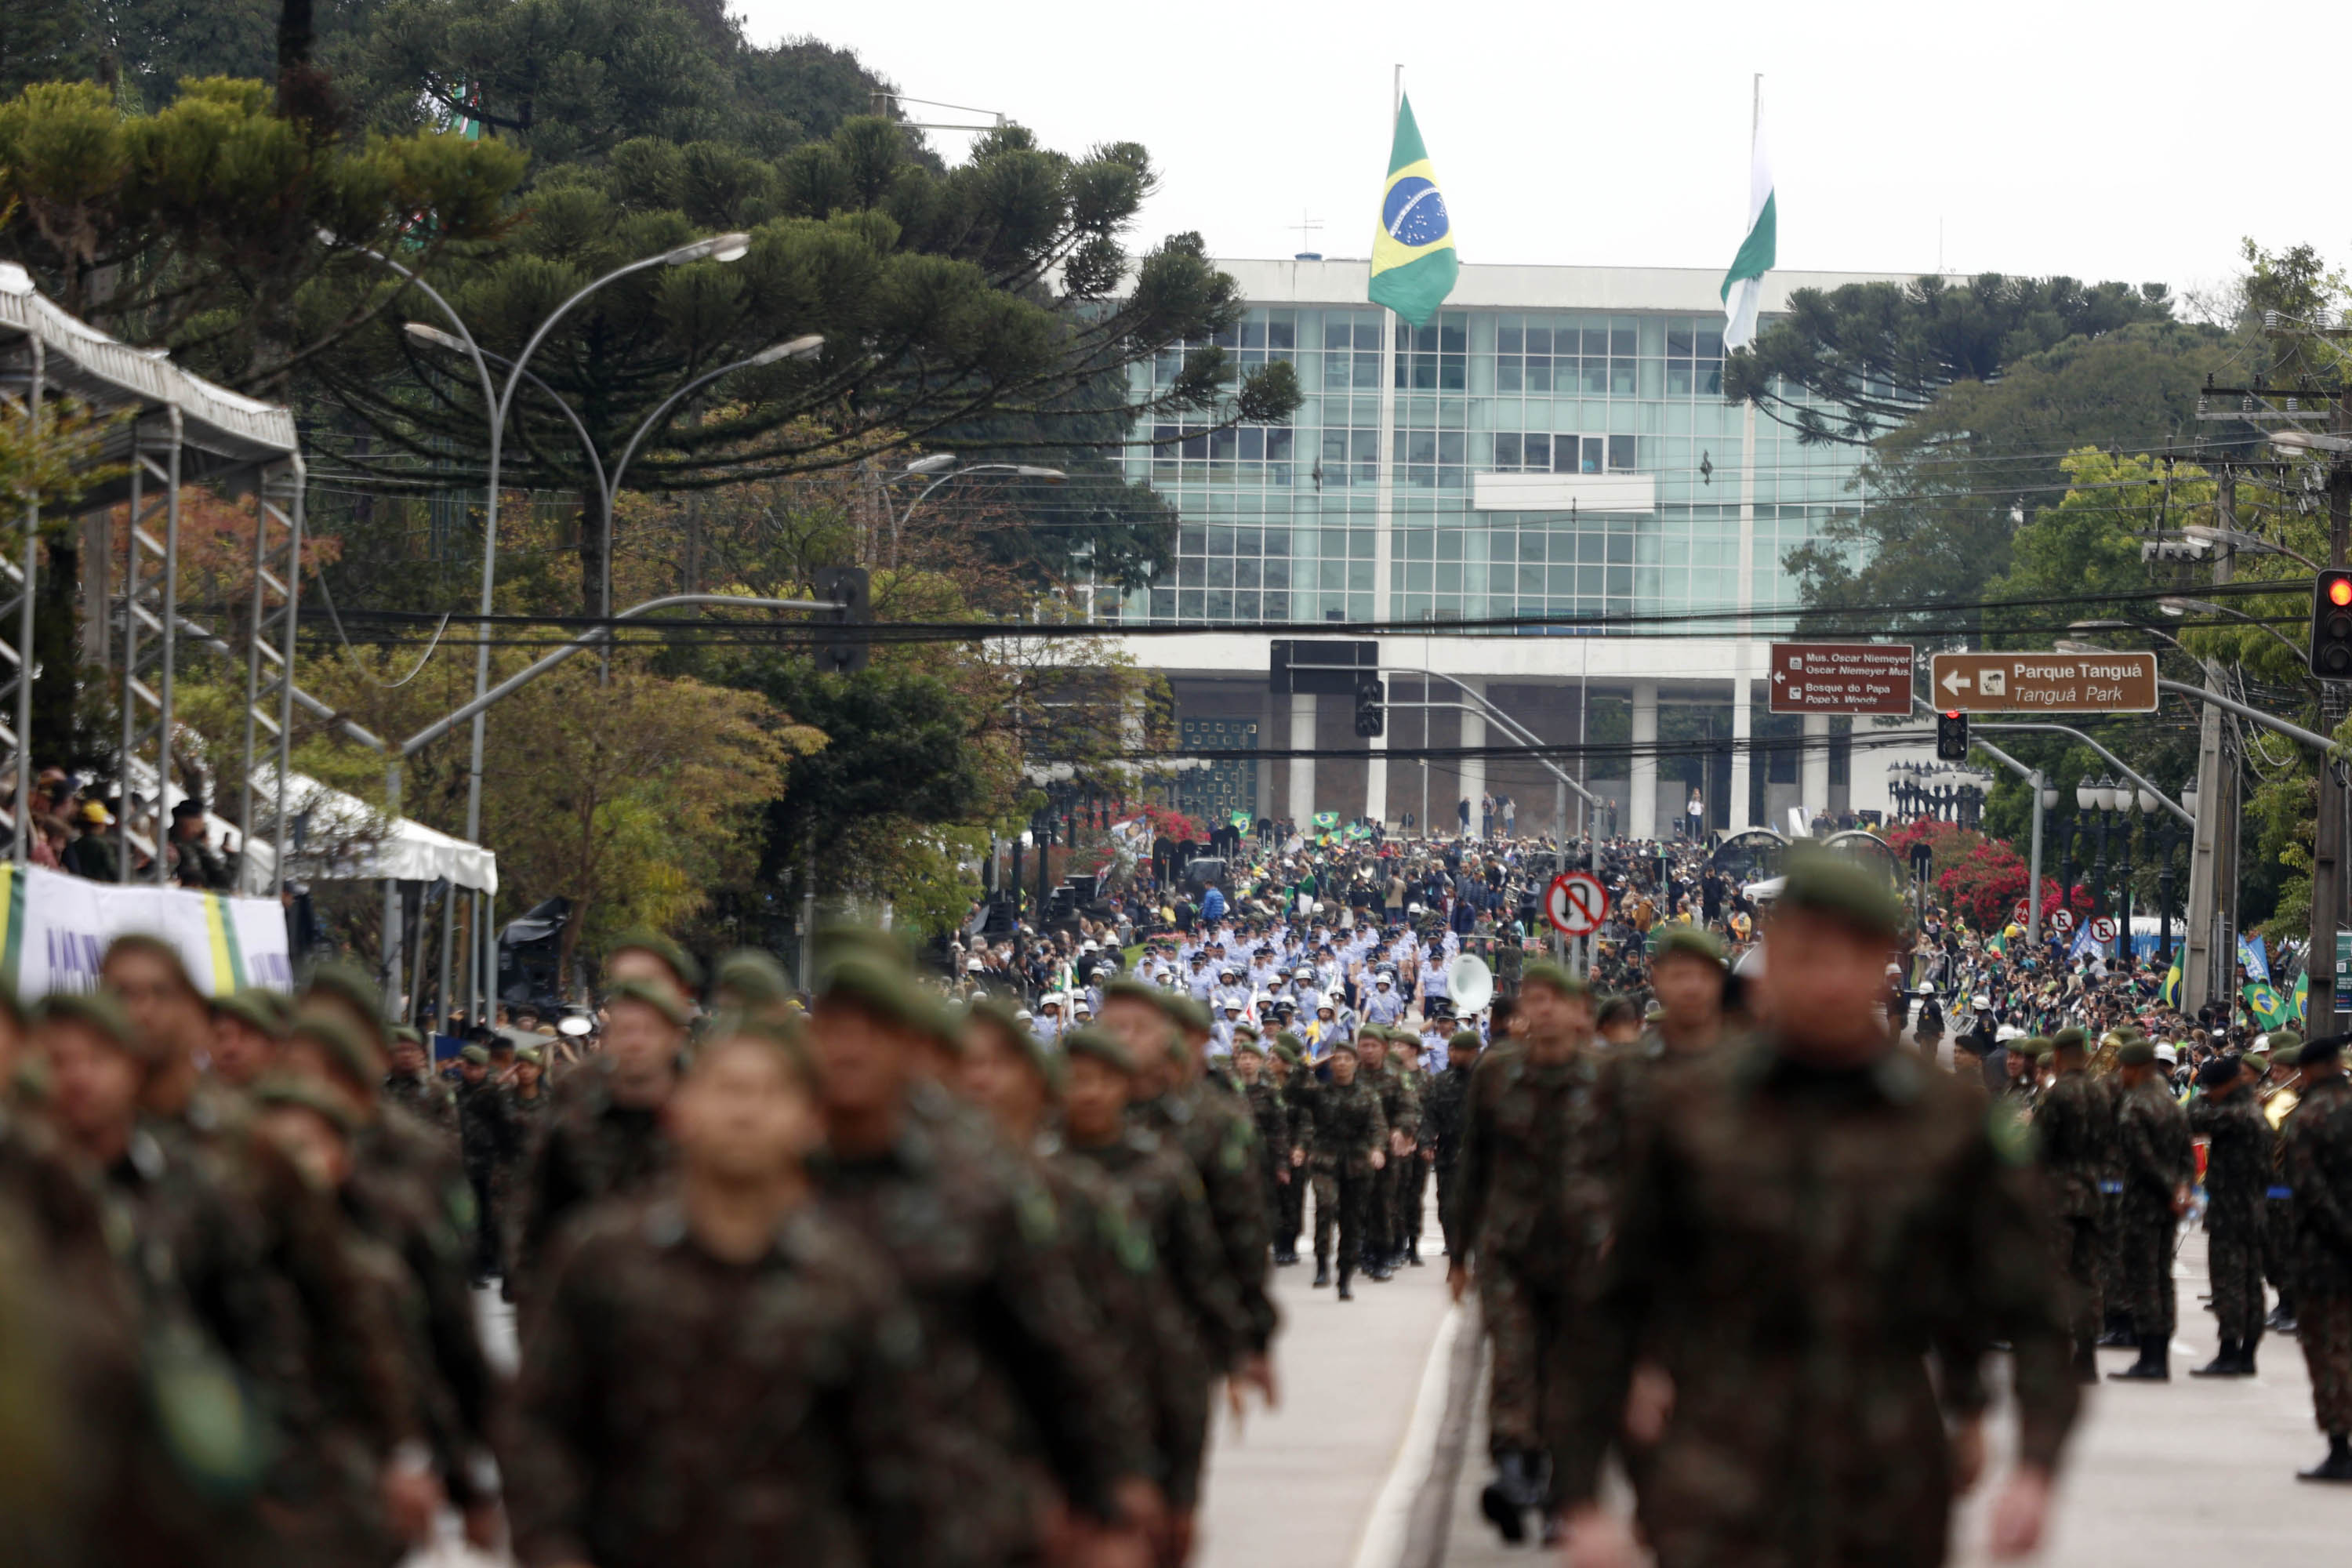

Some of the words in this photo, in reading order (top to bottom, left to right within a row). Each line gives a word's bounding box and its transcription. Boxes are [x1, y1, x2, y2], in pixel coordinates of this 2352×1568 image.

[1806, 653, 1829, 662] Mus.
[1831, 653, 1860, 662] Oscar
[1864, 654, 1910, 666] Niemeyer
[1806, 666, 1835, 674] Oscar
[1839, 666, 1887, 677] Niemeyer
[1889, 667, 1911, 676] Mus.
[2013, 664, 2075, 681] Parque
[2078, 662, 2143, 681] Tanguá
[1806, 683, 1843, 694] Bosque
[1848, 684, 1860, 692] do
[1866, 684, 1890, 694] Papa
[1806, 695, 1838, 704] Pope's
[1845, 695, 1878, 704] Woods
[2015, 687, 2077, 705] Tanguá
[2086, 686, 2122, 702] Park
